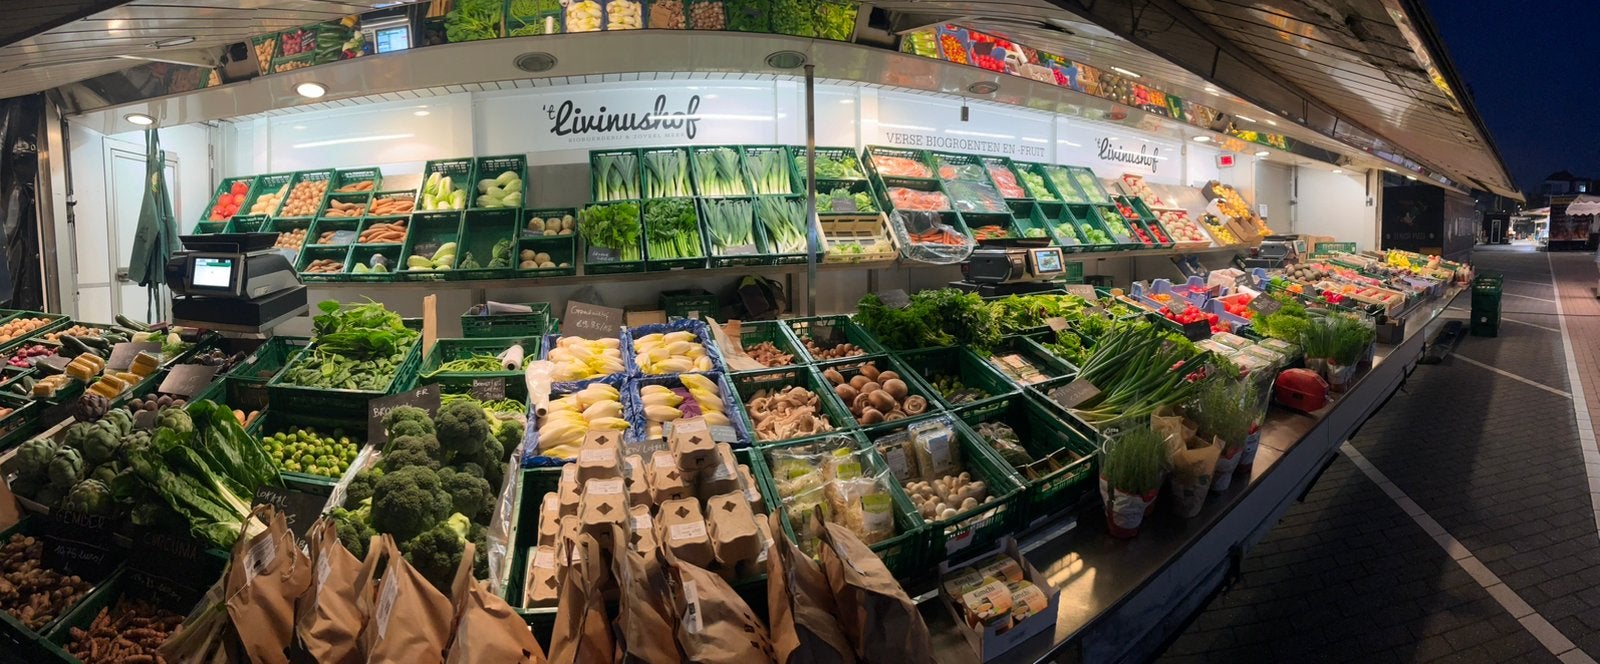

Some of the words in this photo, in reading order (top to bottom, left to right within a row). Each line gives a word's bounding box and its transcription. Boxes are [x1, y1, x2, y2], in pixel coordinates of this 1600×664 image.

[550, 94, 701, 139] Livinushof
[886, 132, 923, 145] VERSE
[926, 135, 1000, 153] BIOGROENTEN
[1003, 143, 1016, 154] EN
[1017, 144, 1046, 158] -FRUIT
[1098, 137, 1159, 173] Livinushof
[973, 585, 996, 598] Kimchi
